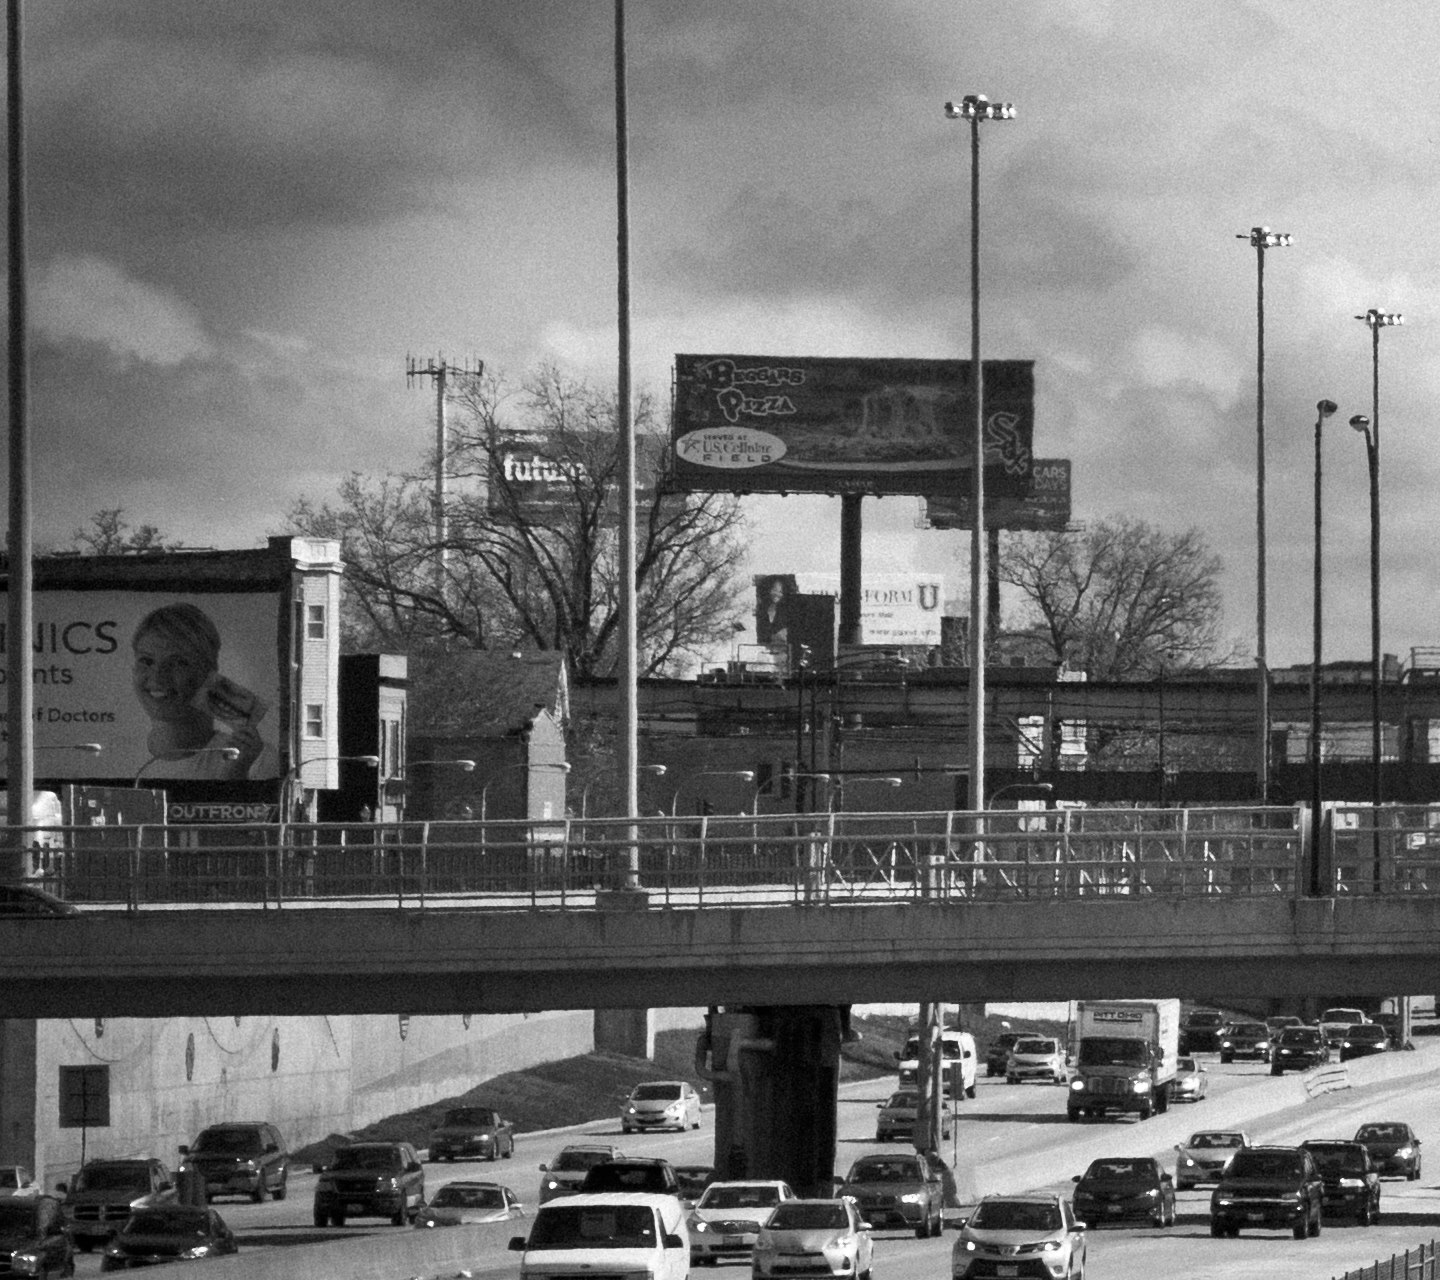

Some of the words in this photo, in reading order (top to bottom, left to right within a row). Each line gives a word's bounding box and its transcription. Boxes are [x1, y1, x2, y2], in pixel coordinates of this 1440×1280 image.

[717, 387, 797, 422] PIZZA
[703, 454, 771, 462] FIELD
[1033, 466, 1068, 479] CARS
[48, 708, 115, 722] Doctors
